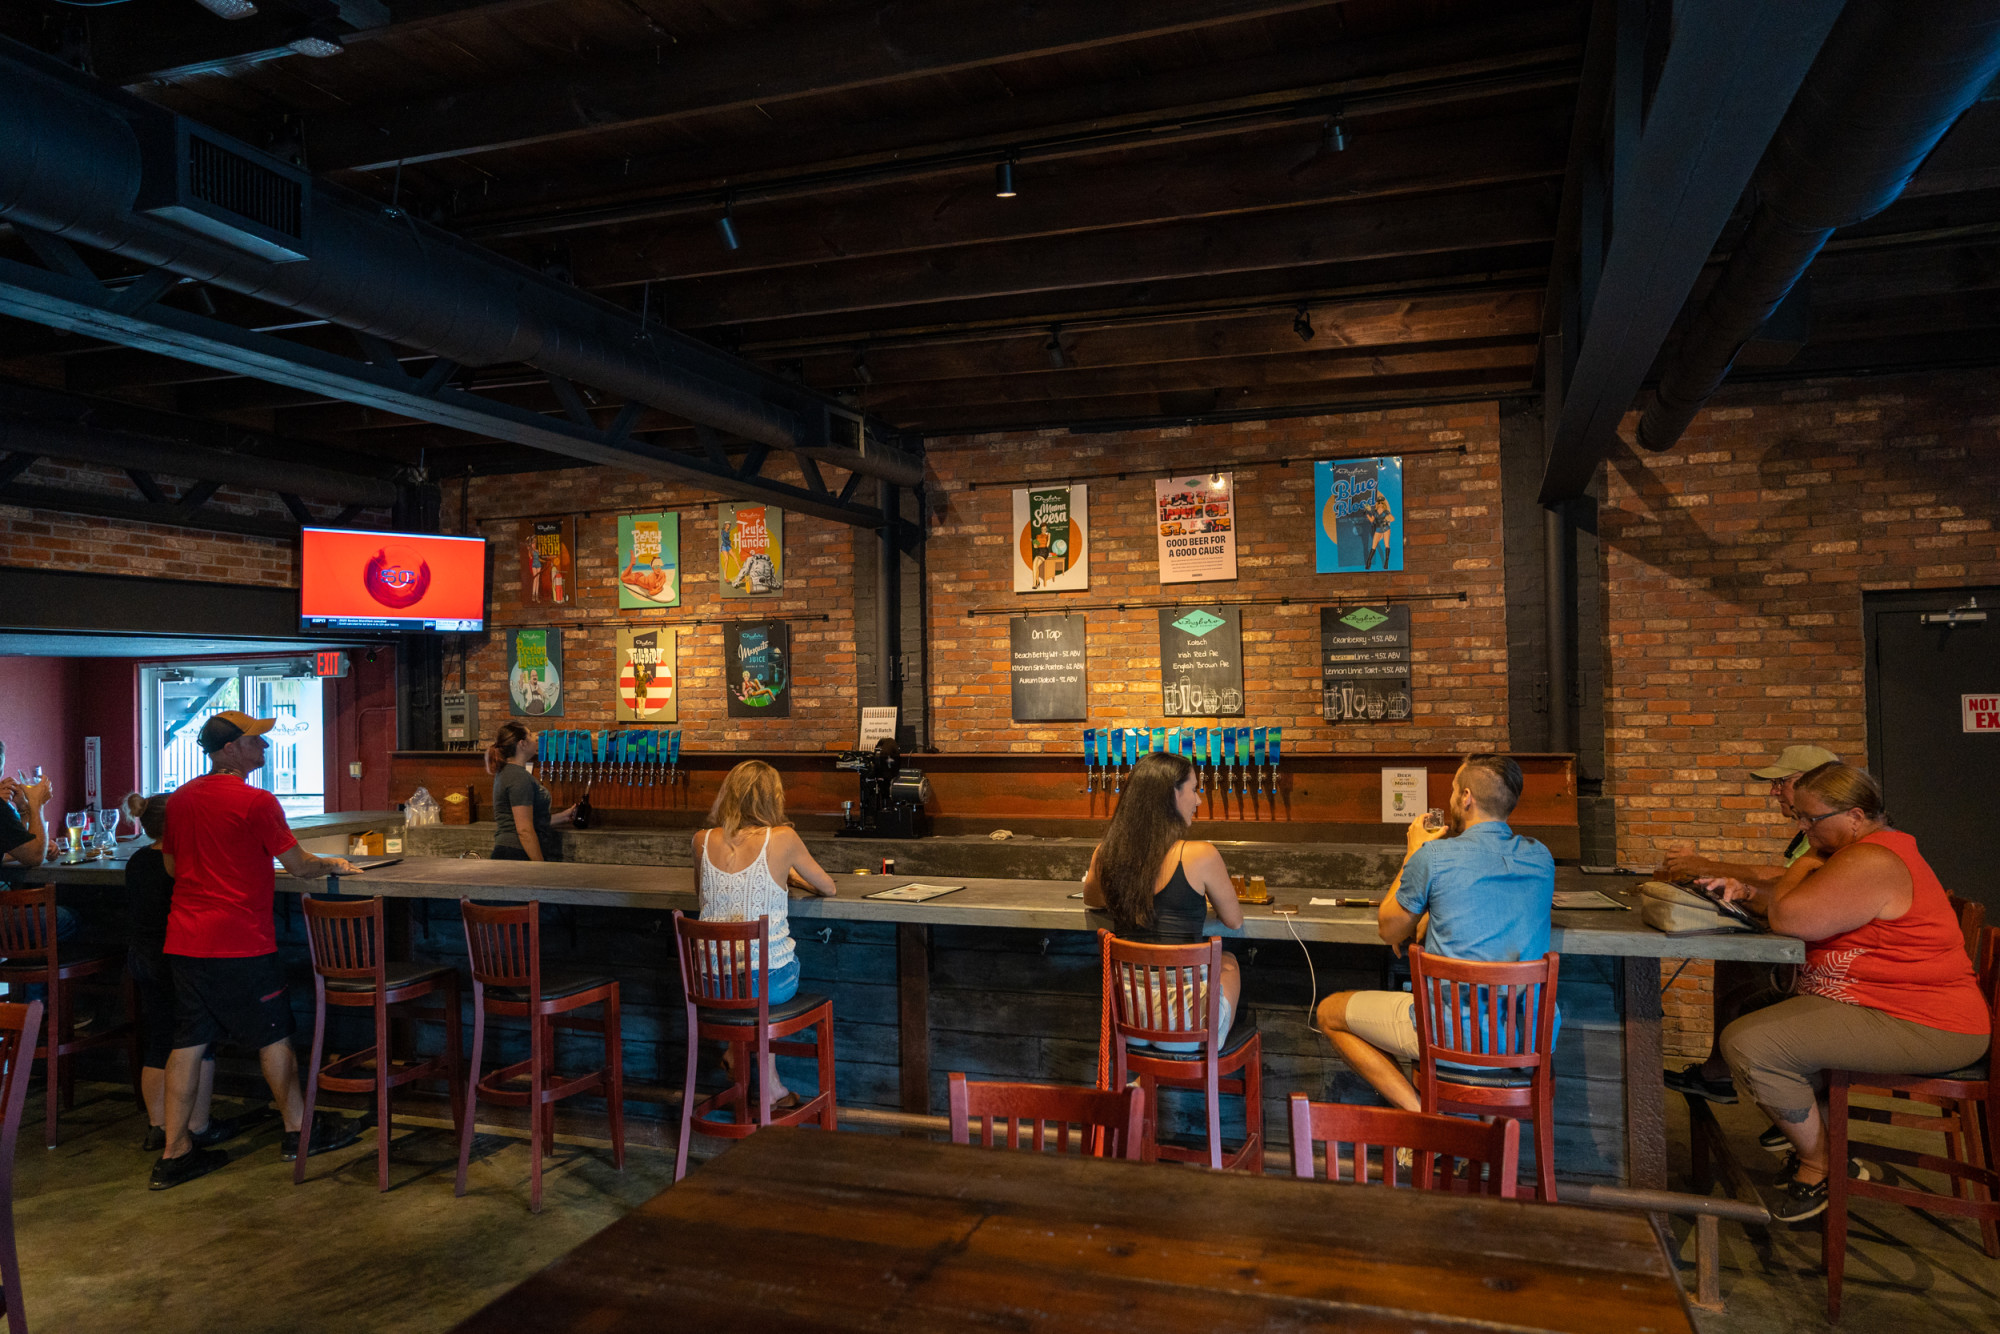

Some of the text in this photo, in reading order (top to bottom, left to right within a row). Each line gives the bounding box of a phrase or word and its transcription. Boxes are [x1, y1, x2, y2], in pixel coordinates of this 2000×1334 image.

[1331, 476, 1377, 502] Blue
[1040, 504, 1067, 516] Mama
[1333, 489, 1376, 518] Blood
[1033, 509, 1067, 527] Seesa
[736, 518, 768, 538] Teufel
[632, 530, 662, 544] BEACH
[734, 532, 770, 554] Hunden
[1166, 535, 1226, 547] GOOD BEER FOR
[539, 543, 560, 556] IRON
[634, 543, 662, 557] BETTY
[1176, 548, 1197, 557] GOOD
[1198, 546, 1224, 555] CAUSE
[381, 570, 415, 584] SC
[1032, 629, 1044, 640] On
[1333, 636, 1367, 646] Cranberry
[738, 641, 769, 662] Mosquito
[1033, 651, 1049, 660] Betty
[317, 652, 340, 676] EXIT
[1969, 699, 1998, 711] NOT
